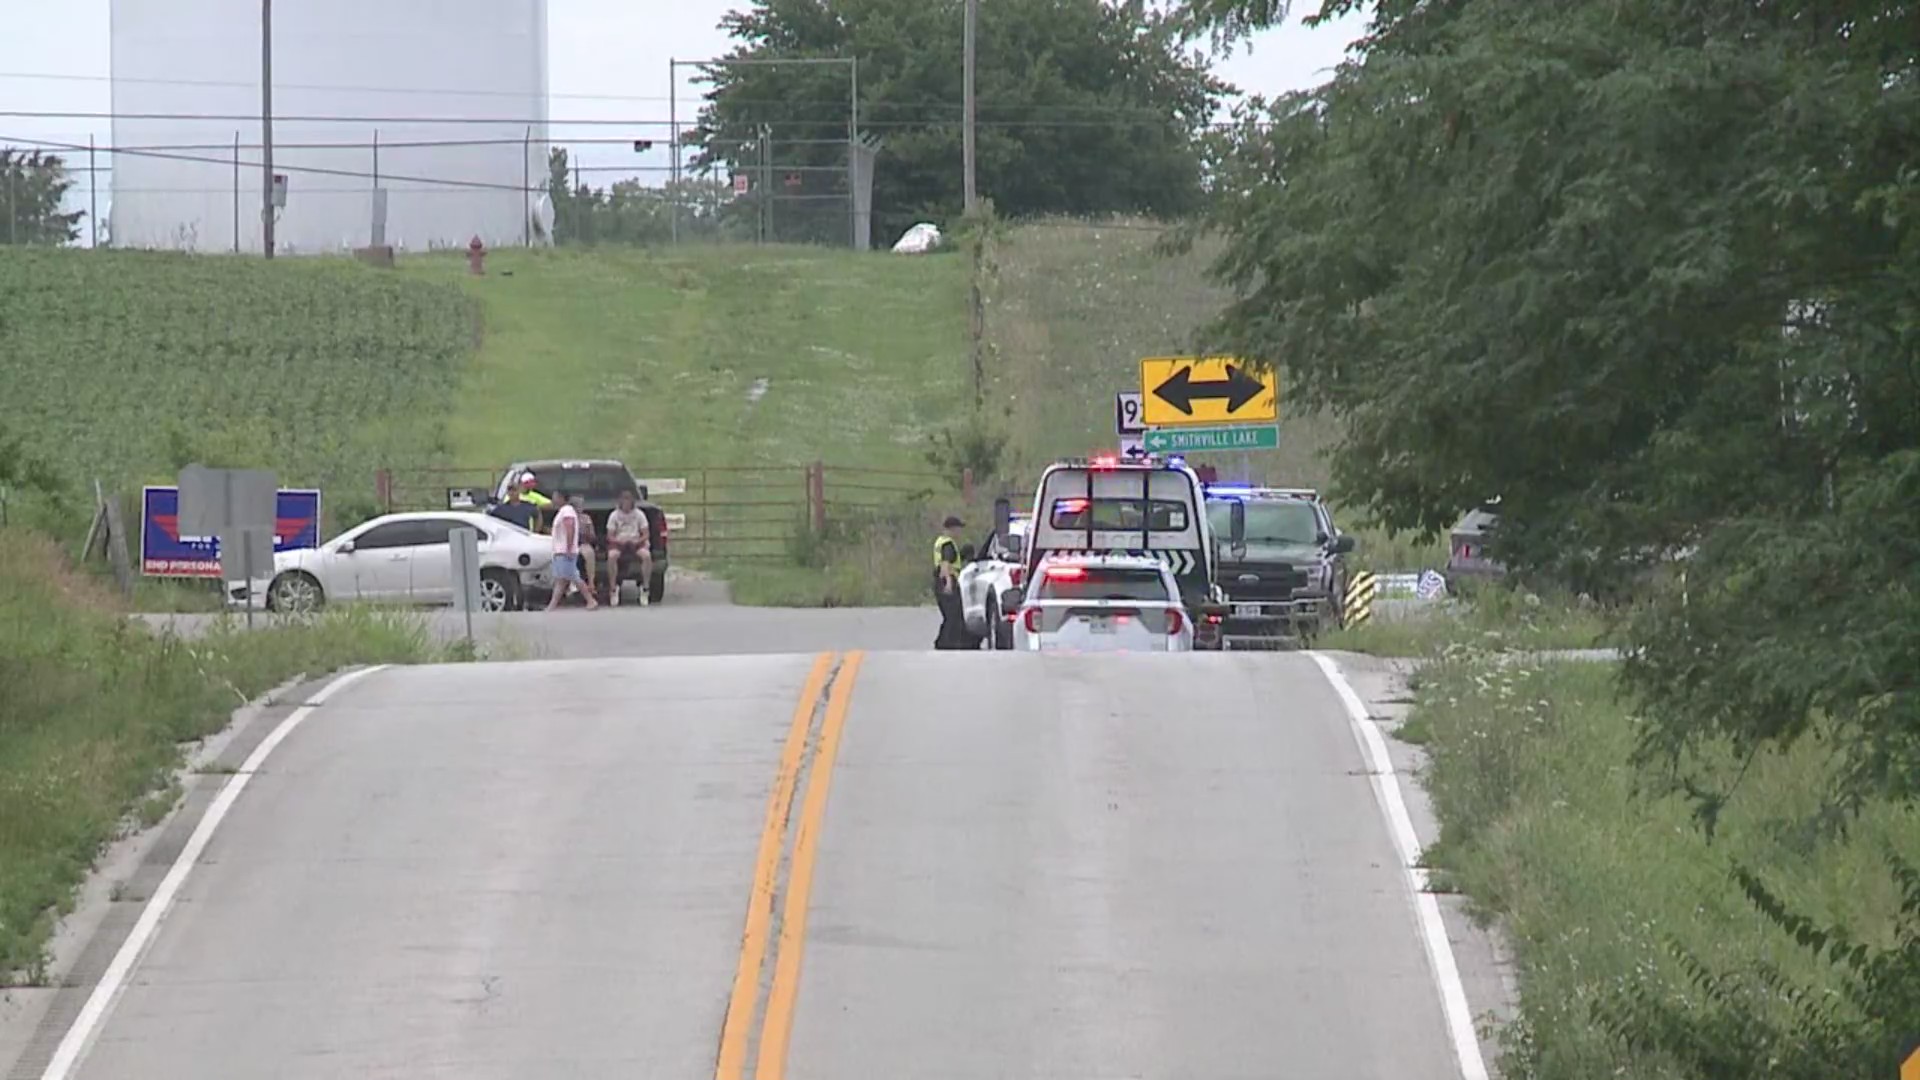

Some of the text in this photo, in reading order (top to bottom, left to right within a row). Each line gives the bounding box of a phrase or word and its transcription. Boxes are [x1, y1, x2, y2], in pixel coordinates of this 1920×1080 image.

[1125, 399, 1143, 423] 9
[1171, 430, 1259, 448] SMITHVILLE LAKE
[169, 560, 222, 571] PERSONA
